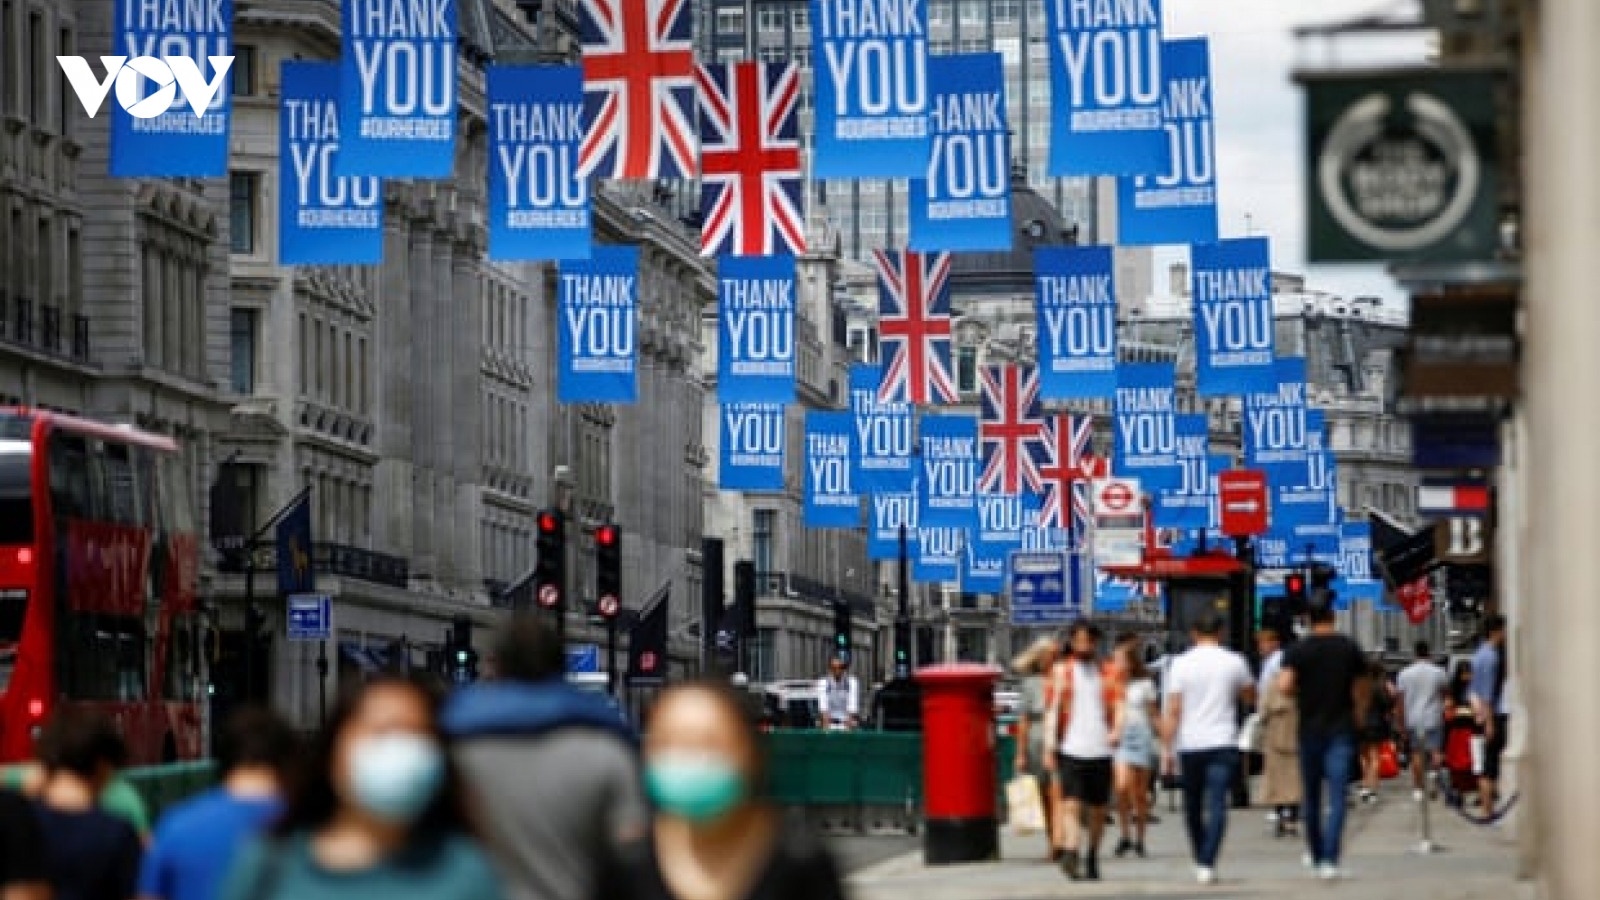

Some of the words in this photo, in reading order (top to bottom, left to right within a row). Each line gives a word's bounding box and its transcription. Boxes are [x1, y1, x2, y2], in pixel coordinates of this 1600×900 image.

[123, 0, 227, 32] THANK
[352, 0, 450, 38] THANK
[821, 0, 922, 37] THANK
[1057, 0, 1157, 28] THANK
[354, 40, 451, 116] YOU
[824, 38, 926, 115] YOU
[1058, 28, 1160, 106] YOU
[285, 99, 339, 140] THA
[493, 102, 583, 142] THANK
[929, 92, 1001, 132] HANK
[499, 145, 588, 207] YOU
[562, 275, 635, 306] THANK
[722, 279, 791, 308] THANK
[1042, 275, 1110, 304] THANK
[1199, 268, 1268, 301] THANK
[567, 307, 633, 355] YOU
[728, 311, 793, 359] YOU
[1045, 306, 1113, 355] YOU
[1202, 300, 1271, 350] YOU
[728, 413, 783, 453] YOU
[857, 416, 911, 456] YOU
[1120, 415, 1174, 453] YOU
[1250, 409, 1304, 447] YOU
[925, 462, 973, 495] YOU
[875, 498, 916, 528] YOU
[978, 498, 1020, 530] YOU
[1447, 517, 1485, 556] B
